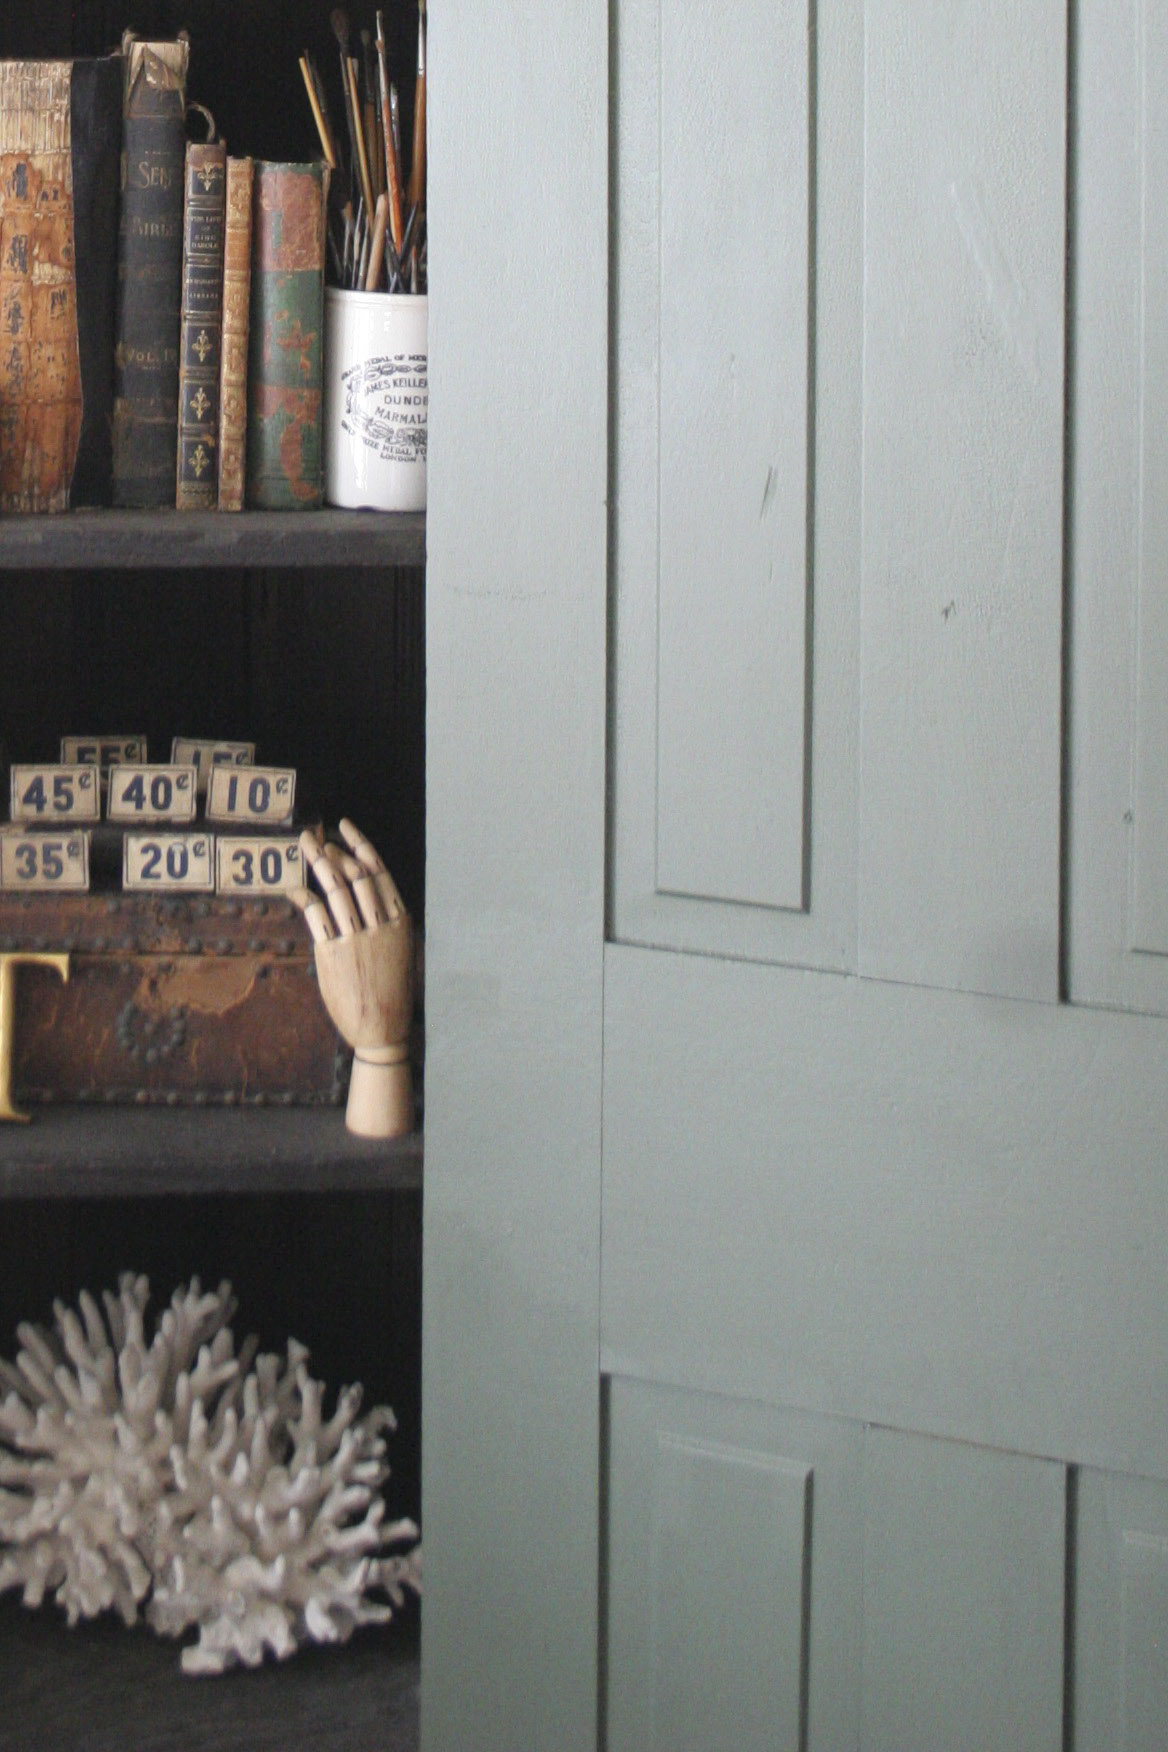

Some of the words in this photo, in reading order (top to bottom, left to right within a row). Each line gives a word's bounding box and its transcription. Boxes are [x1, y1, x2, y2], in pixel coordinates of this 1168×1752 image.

[394, 353, 406, 361] OF
[364, 378, 391, 395] AMES
[22, 771, 91, 813] 45¢
[121, 773, 189, 811] 40¢
[227, 775, 289, 813] 10¢
[15, 841, 80, 879] 35¢
[140, 840, 205, 880] 20¢
[232, 844, 298, 886] 30¢
